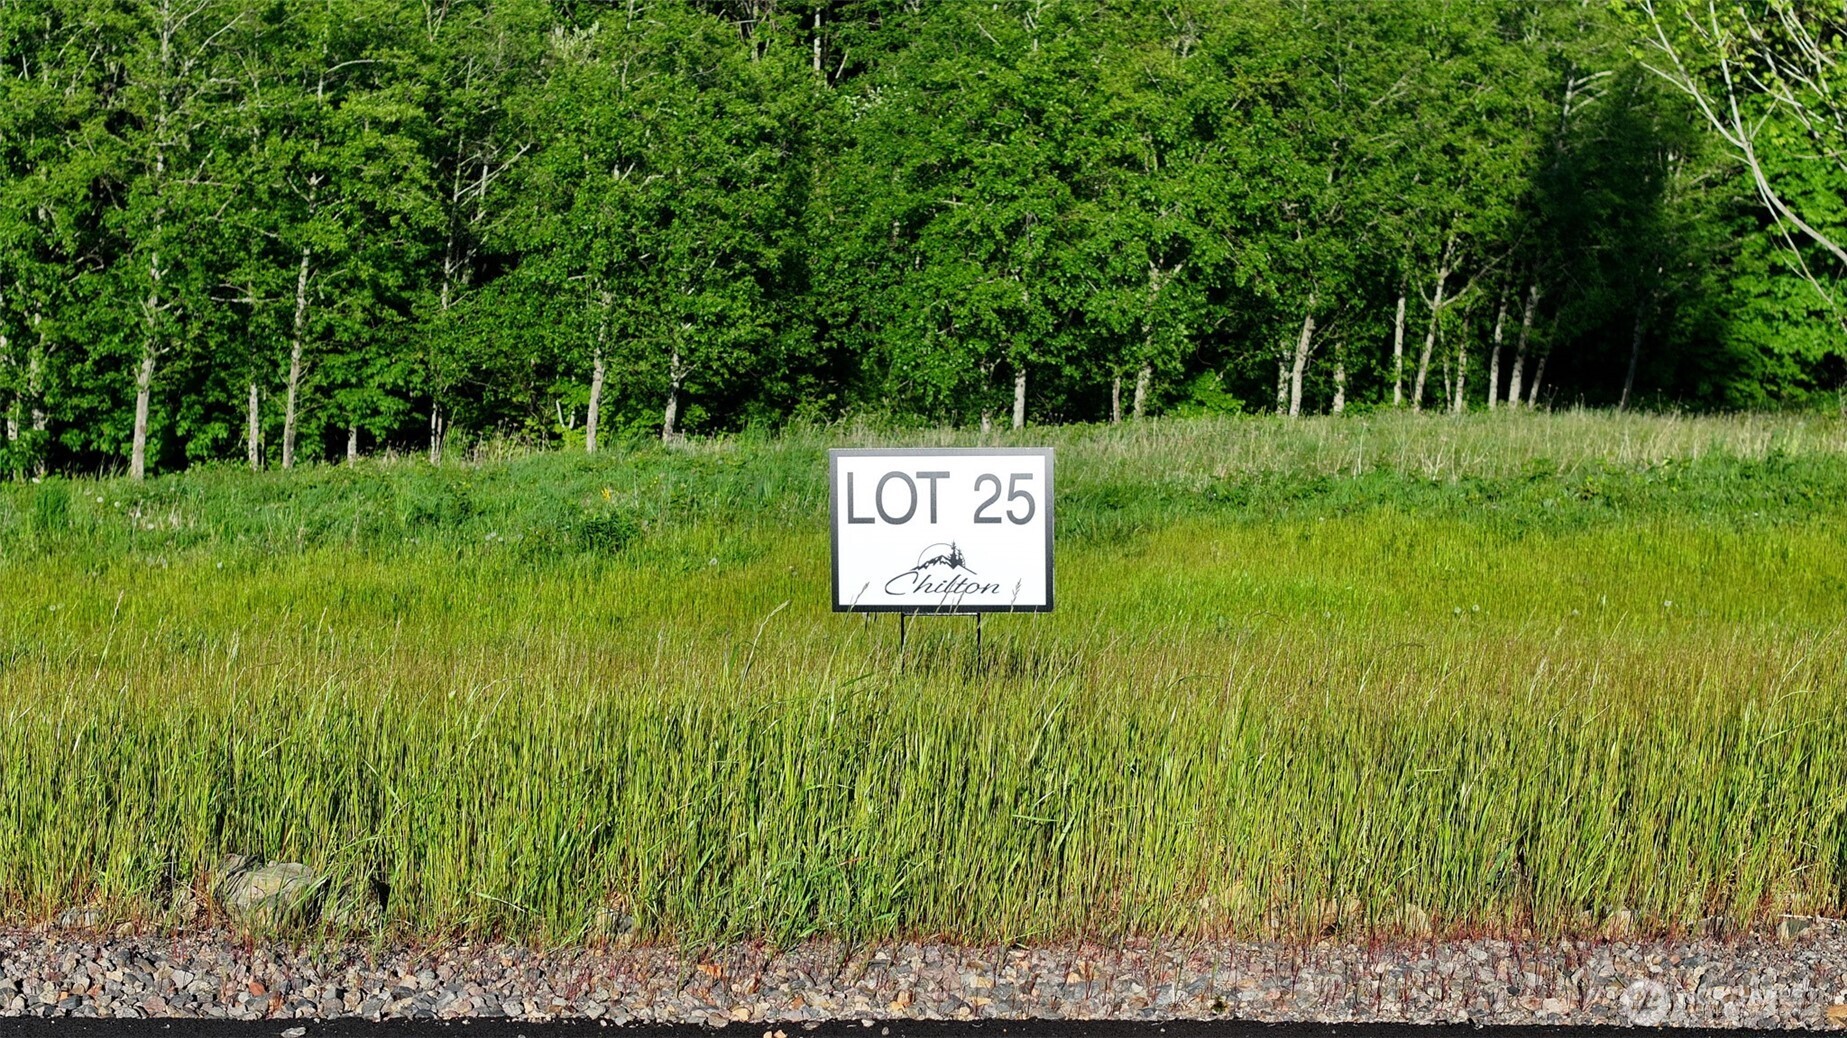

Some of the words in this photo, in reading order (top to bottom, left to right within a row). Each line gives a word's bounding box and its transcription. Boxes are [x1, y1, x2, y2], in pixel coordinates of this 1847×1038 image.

[847, 471, 950, 525] LOT
[973, 473, 1036, 525] 25
[884, 571, 1000, 595] Chilton
